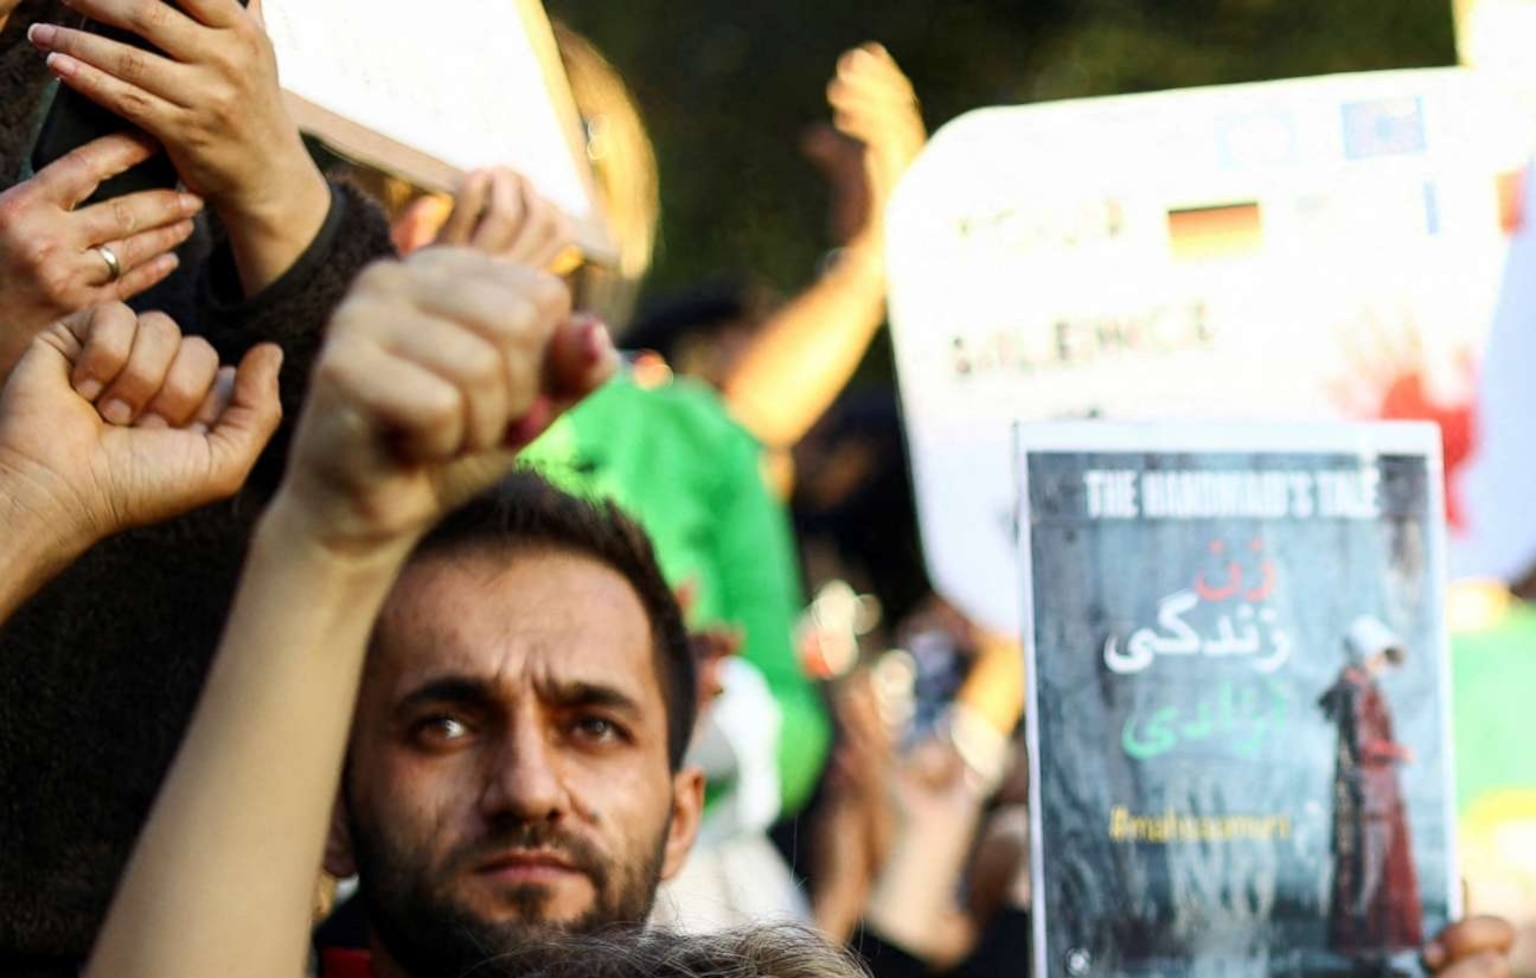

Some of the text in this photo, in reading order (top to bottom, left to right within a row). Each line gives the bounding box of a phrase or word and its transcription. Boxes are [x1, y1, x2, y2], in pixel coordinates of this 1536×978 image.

[1083, 470, 1380, 518] THE HANDMAID'S TALE
[1195, 540, 1278, 602] زن
[1104, 589, 1292, 674] زندگی
